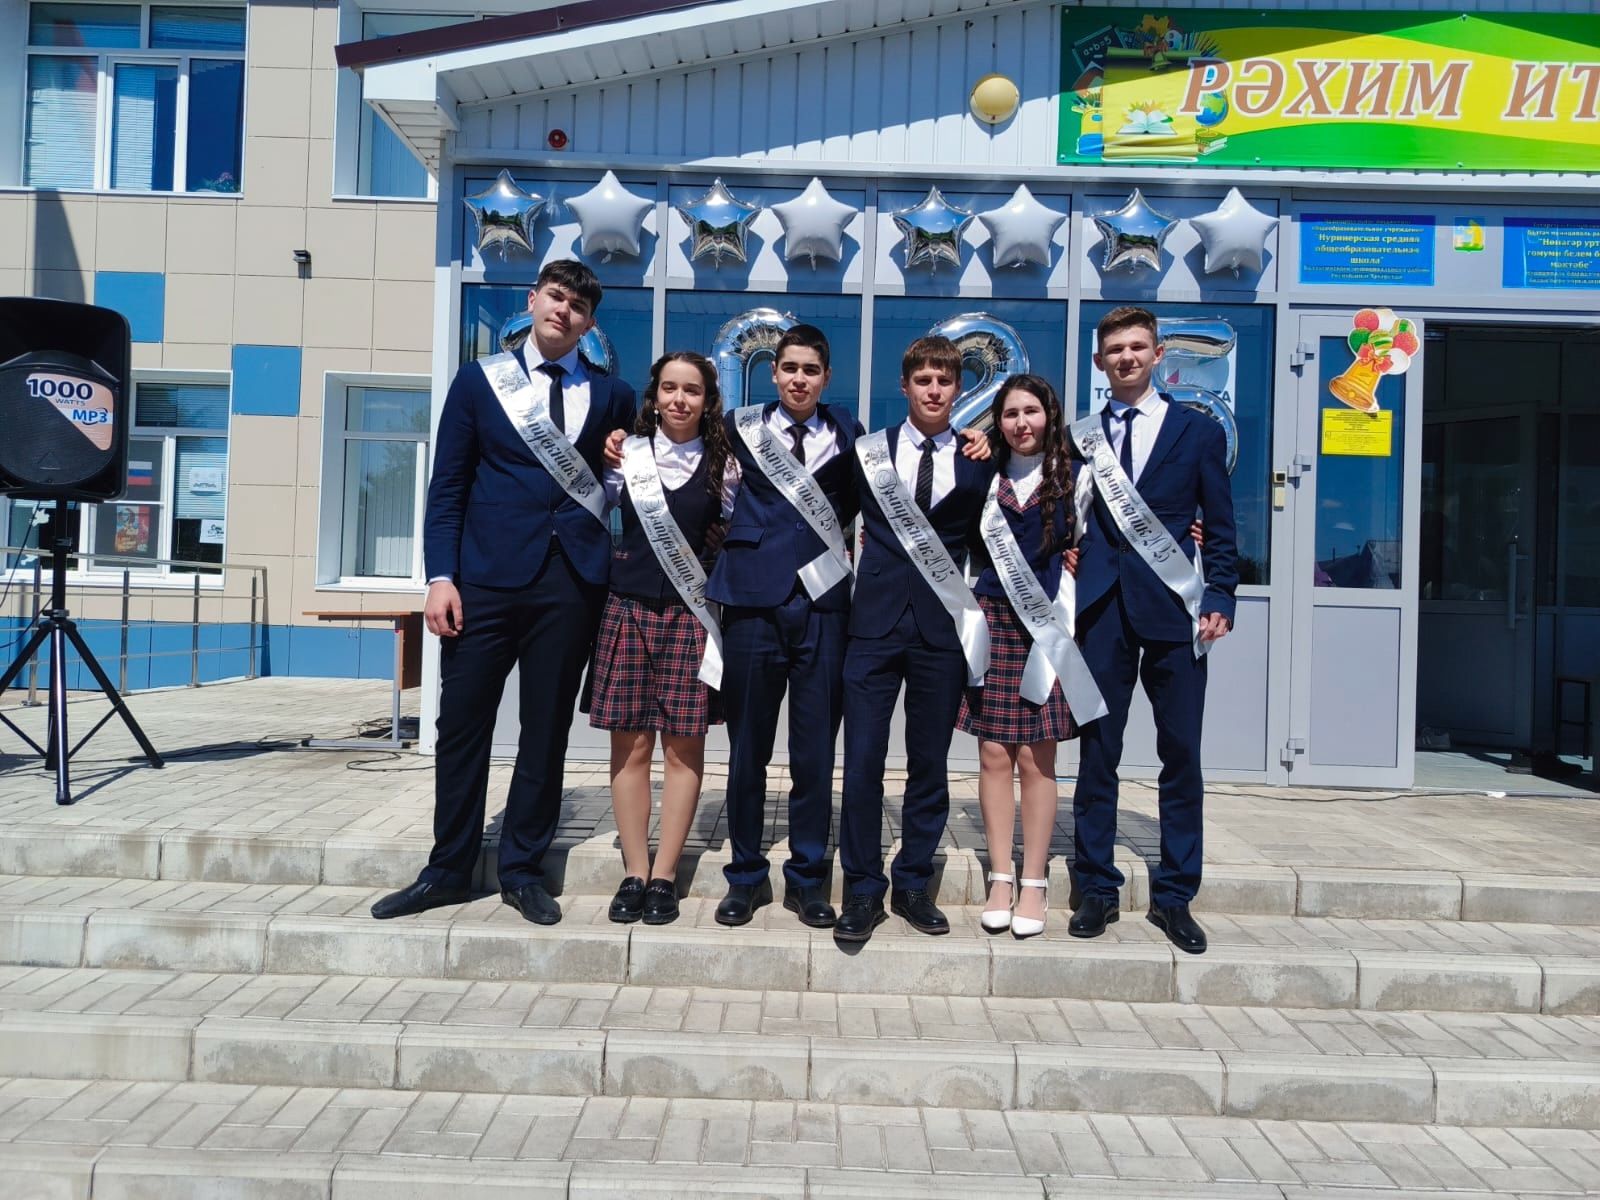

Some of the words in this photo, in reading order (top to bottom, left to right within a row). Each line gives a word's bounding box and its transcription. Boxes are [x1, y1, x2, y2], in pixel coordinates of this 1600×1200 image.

[1179, 57, 1472, 118] РӘХИМ
[27, 378, 93, 400] 1000
[55, 398, 86, 407] WATTS
[72, 408, 108, 423] MP3
[751, 428, 817, 509] Выпускник
[1094, 452, 1152, 538] Выпускник
[874, 469, 934, 557] Выпускник
[924, 551, 955, 583] 2025
